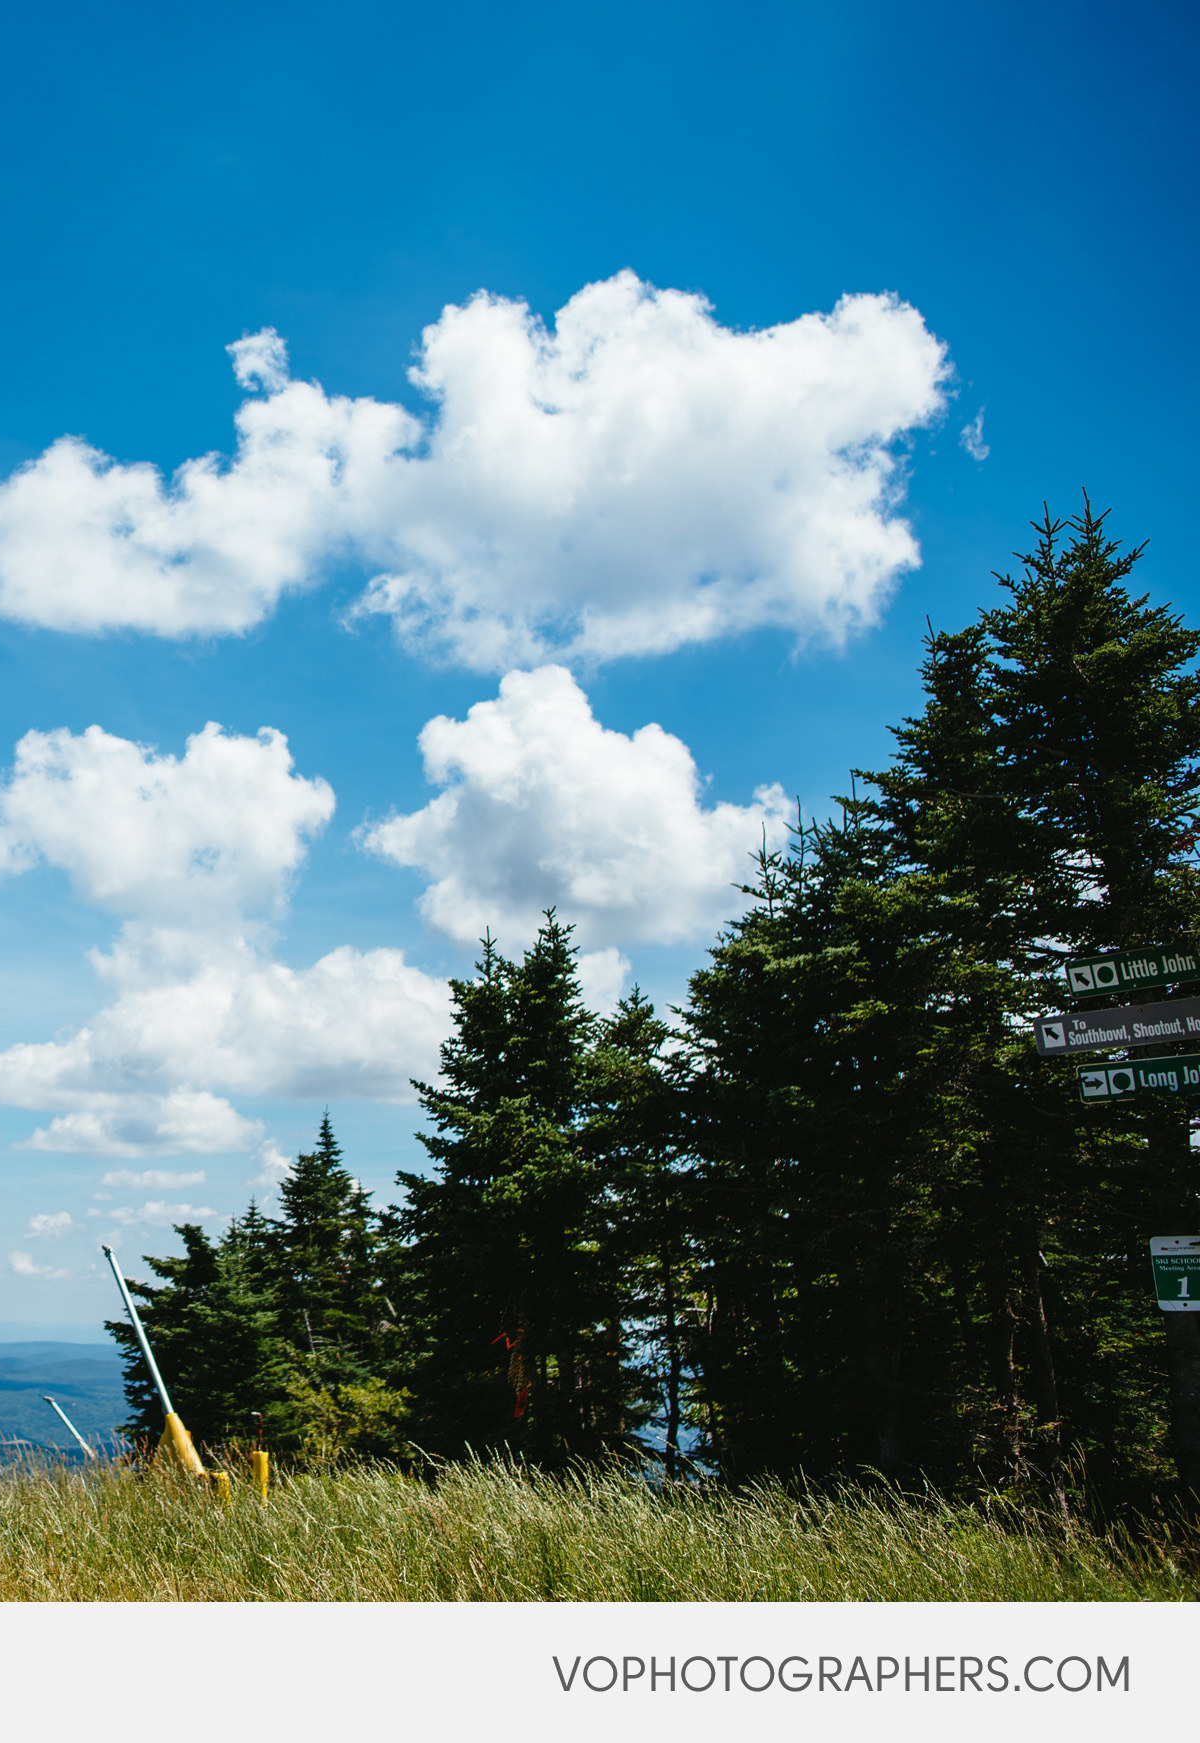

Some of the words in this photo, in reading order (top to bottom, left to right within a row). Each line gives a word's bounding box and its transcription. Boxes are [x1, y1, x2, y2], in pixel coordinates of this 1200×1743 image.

[1121, 959, 1158, 980] Little
[1162, 953, 1196, 974] John
[1068, 1025, 1131, 1046] Southbowl,
[1133, 1018, 1185, 1038] Shootout,
[1072, 1019, 1086, 1030] To
[1139, 1070, 1178, 1091] Long
[1183, 1064, 1200, 1085] Jo
[1177, 1276, 1190, 1298] 1
